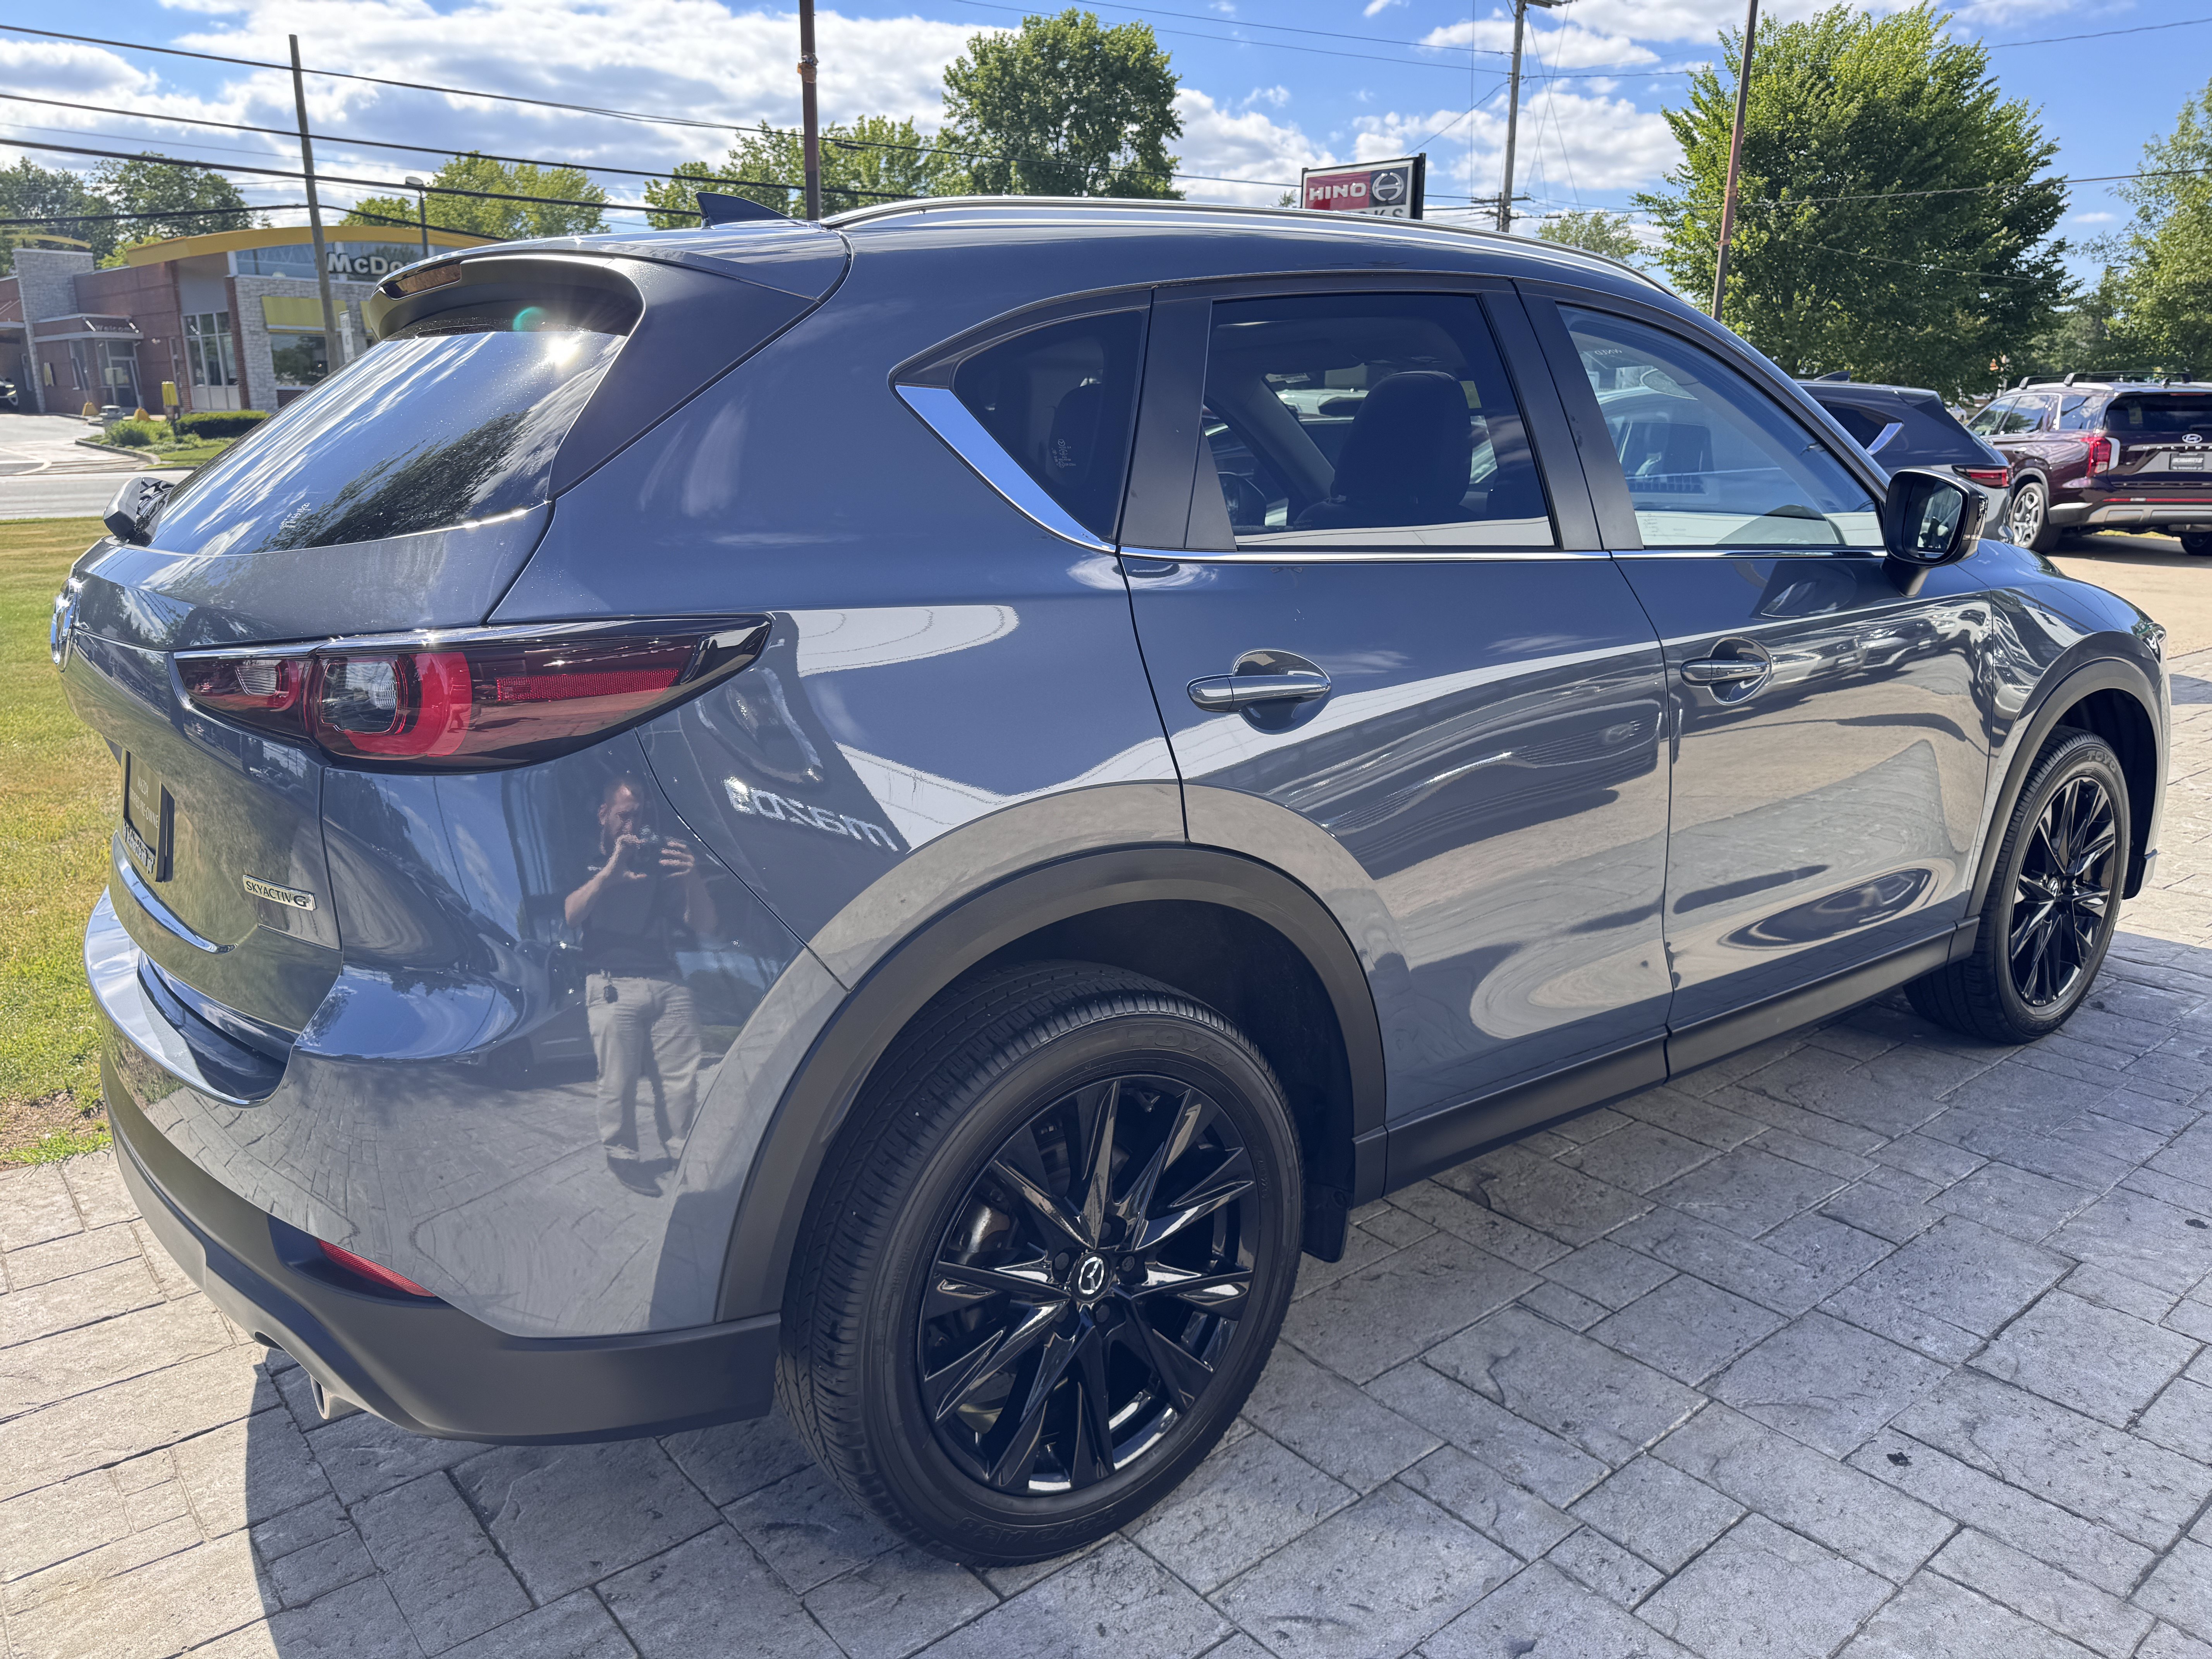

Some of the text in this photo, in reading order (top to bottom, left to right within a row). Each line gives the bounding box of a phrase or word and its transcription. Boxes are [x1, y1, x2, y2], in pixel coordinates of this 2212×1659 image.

[1309, 182, 1367, 201] HINO
[327, 252, 410, 275] McDo
[2087, 750, 2117, 774] TOYO
[137, 775, 149, 799] MAZDA
[140, 799, 158, 828] PRE-OWNE
[1127, 1029, 1231, 1066] TOYO
